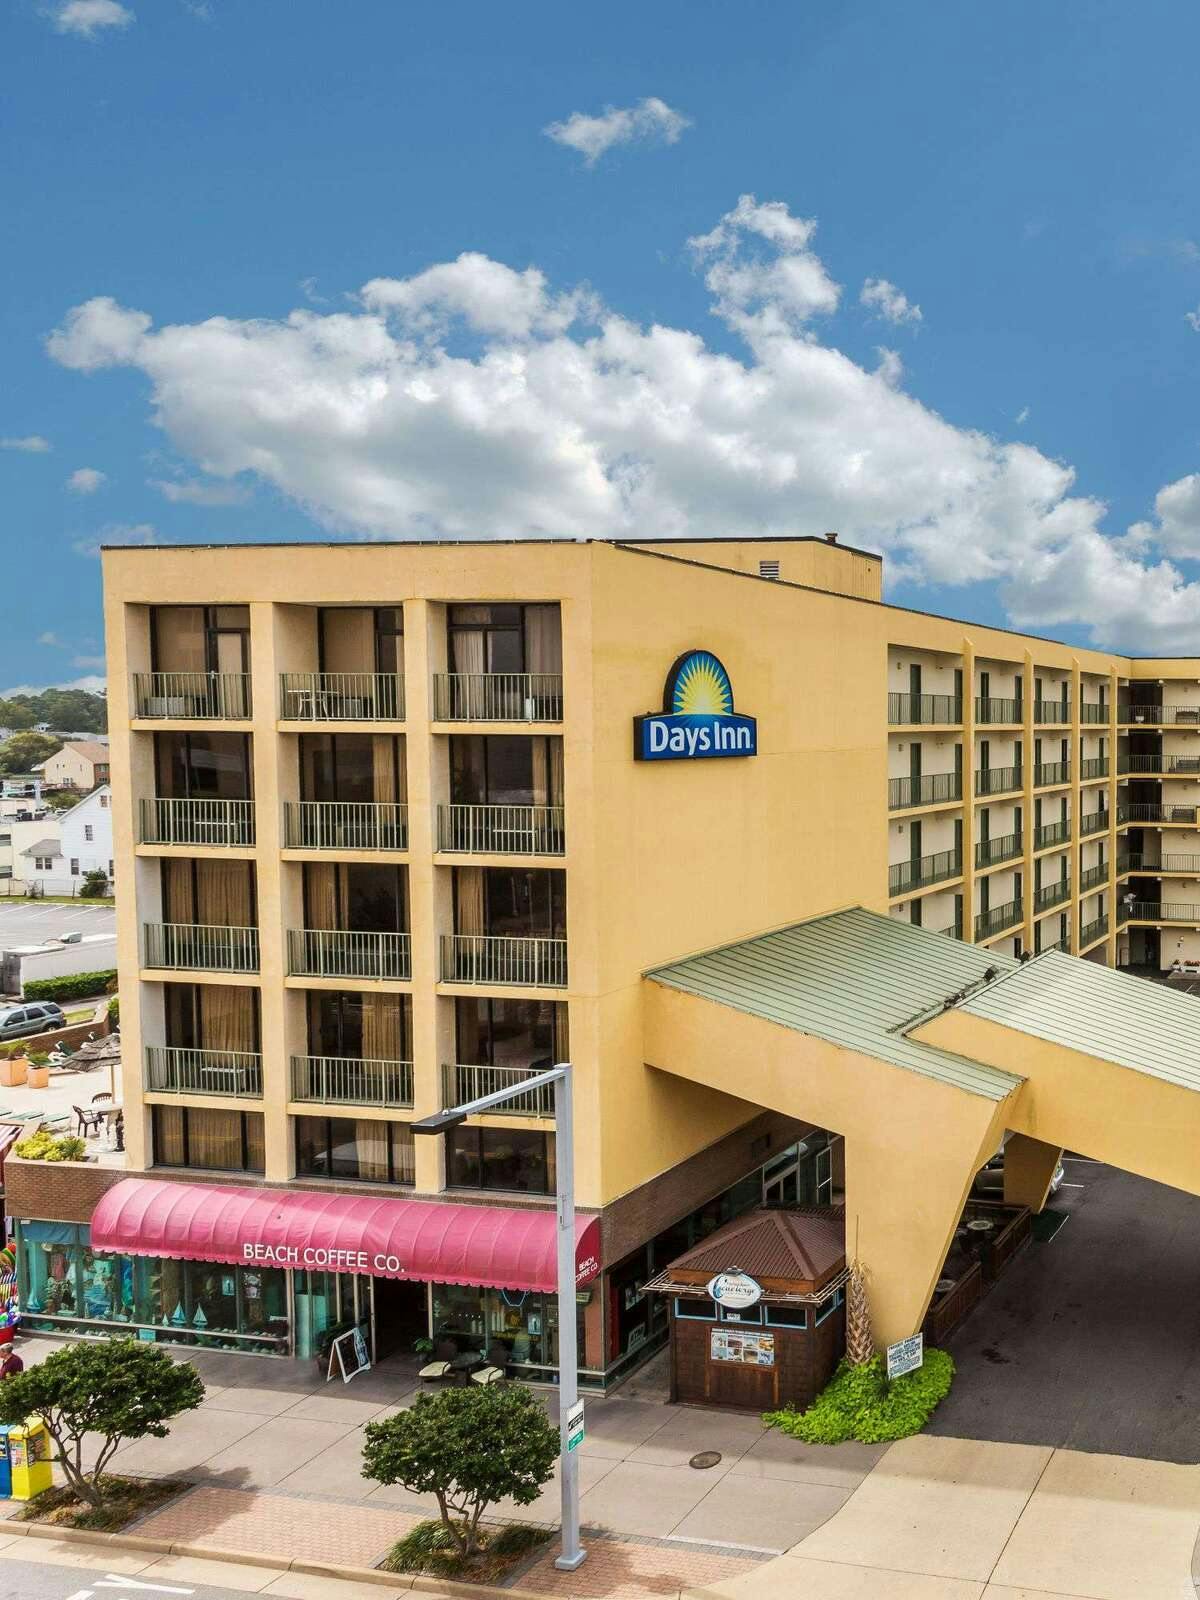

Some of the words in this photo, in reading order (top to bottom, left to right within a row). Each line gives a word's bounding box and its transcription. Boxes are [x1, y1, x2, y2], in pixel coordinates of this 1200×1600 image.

[650, 721, 711, 756] Days
[714, 721, 751, 749] Inn
[243, 1243, 298, 1263] BEACH
[303, 1247, 368, 1267] COFFEE
[374, 1254, 405, 1273] CO.
[578, 1256, 595, 1271] BEACH
[576, 1265, 591, 1282] OFFEE
